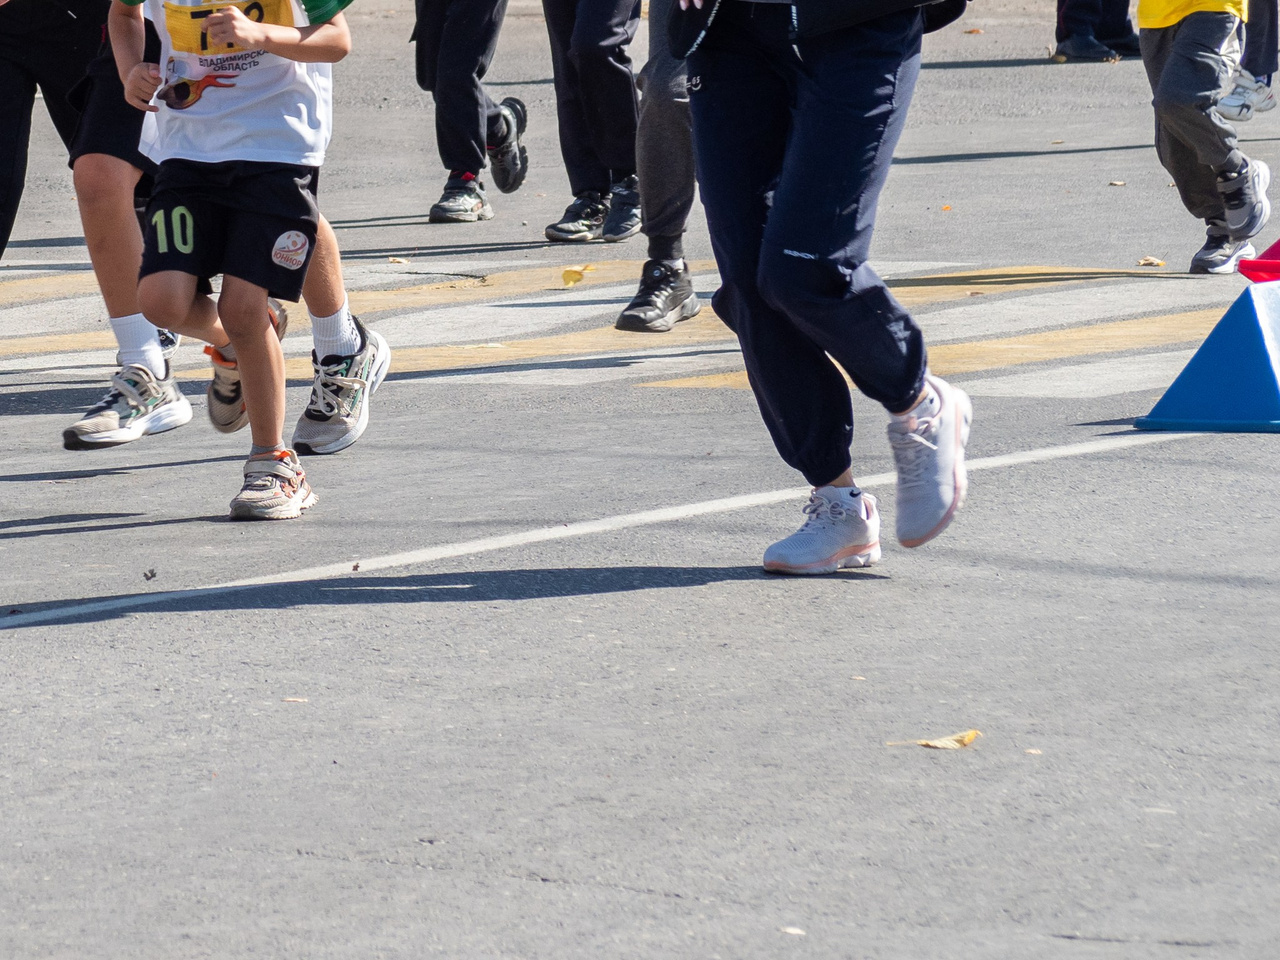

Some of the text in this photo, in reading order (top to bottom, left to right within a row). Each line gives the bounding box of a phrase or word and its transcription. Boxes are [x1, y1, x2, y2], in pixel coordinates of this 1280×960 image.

[199, 49, 269, 67] ВЛАДИМИРСКА
[213, 59, 259, 71] ОБЛАСТЬ
[152, 205, 195, 255] 10
[273, 250, 302, 266] ЮНИОР
